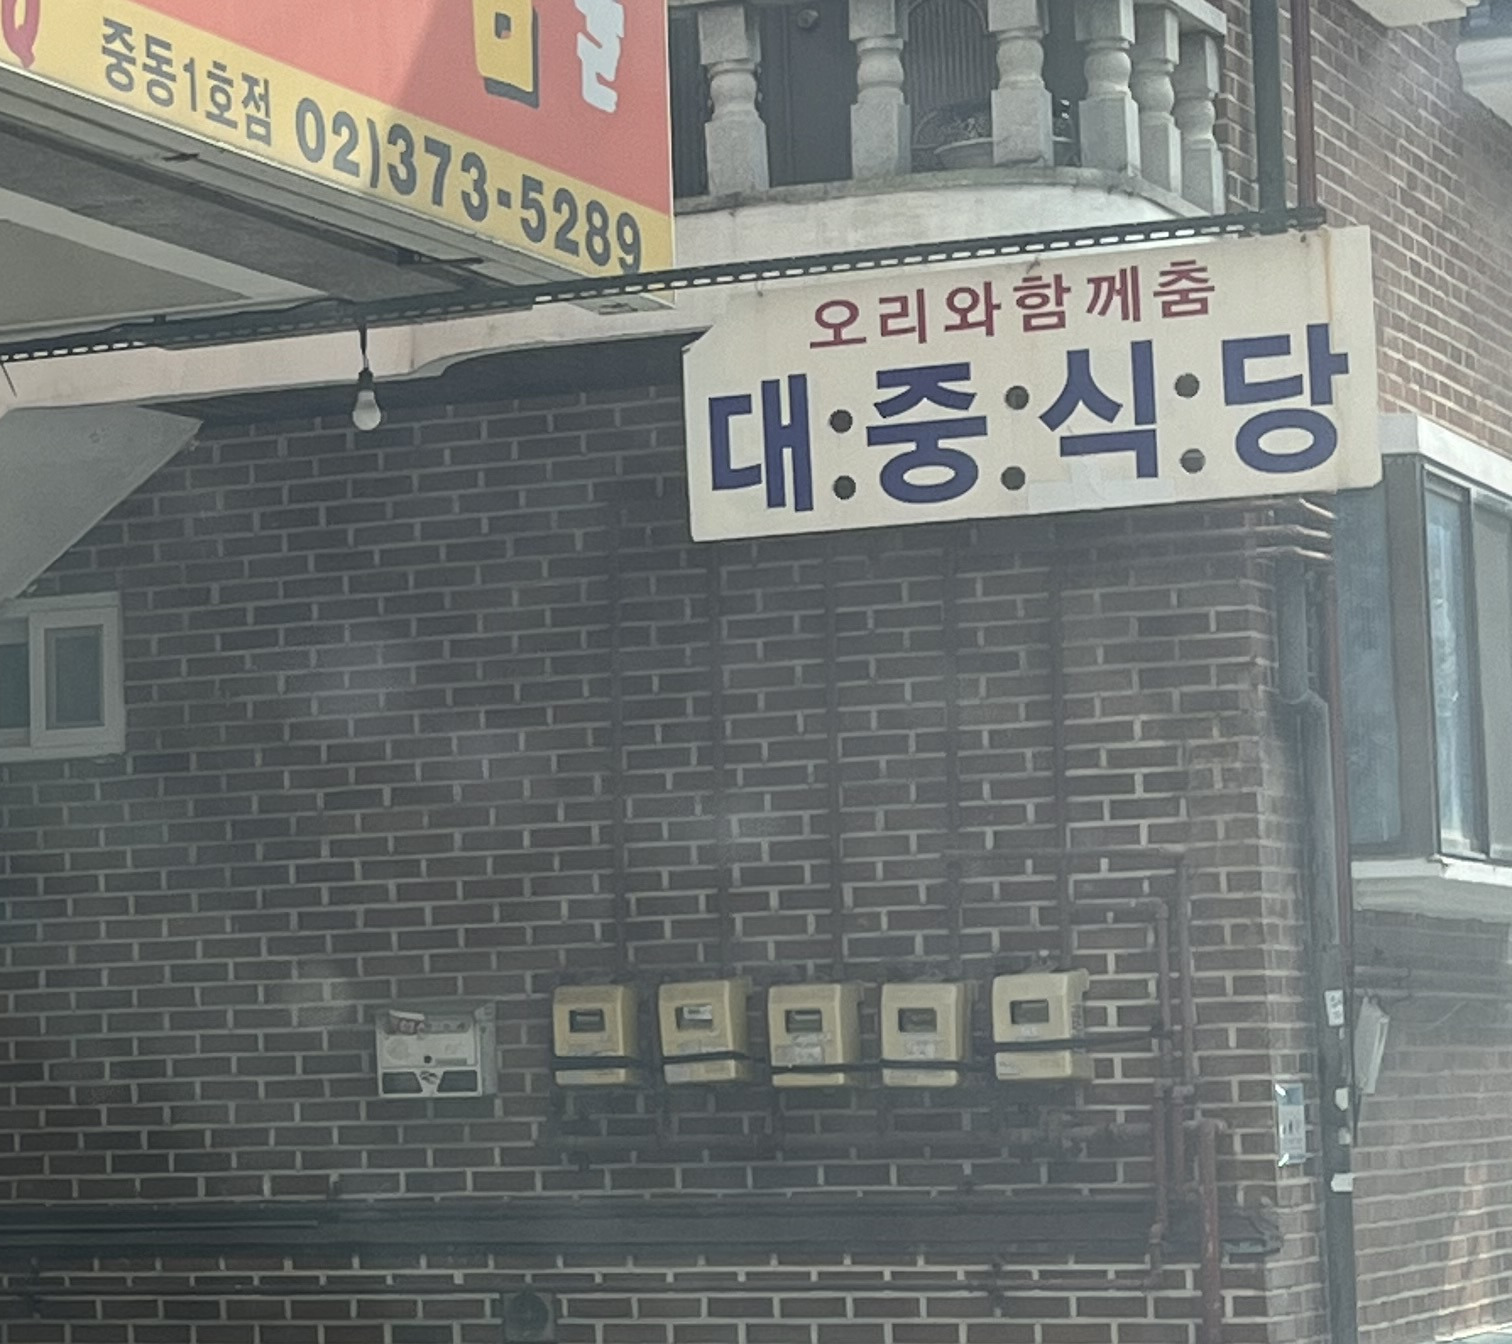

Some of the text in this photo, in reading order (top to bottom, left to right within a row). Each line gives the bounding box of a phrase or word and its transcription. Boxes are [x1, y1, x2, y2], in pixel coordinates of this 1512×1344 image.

[101, 16, 643, 276] 중동1호점 02)373-5289
[809, 257, 1216, 349] 오리와함께춤
